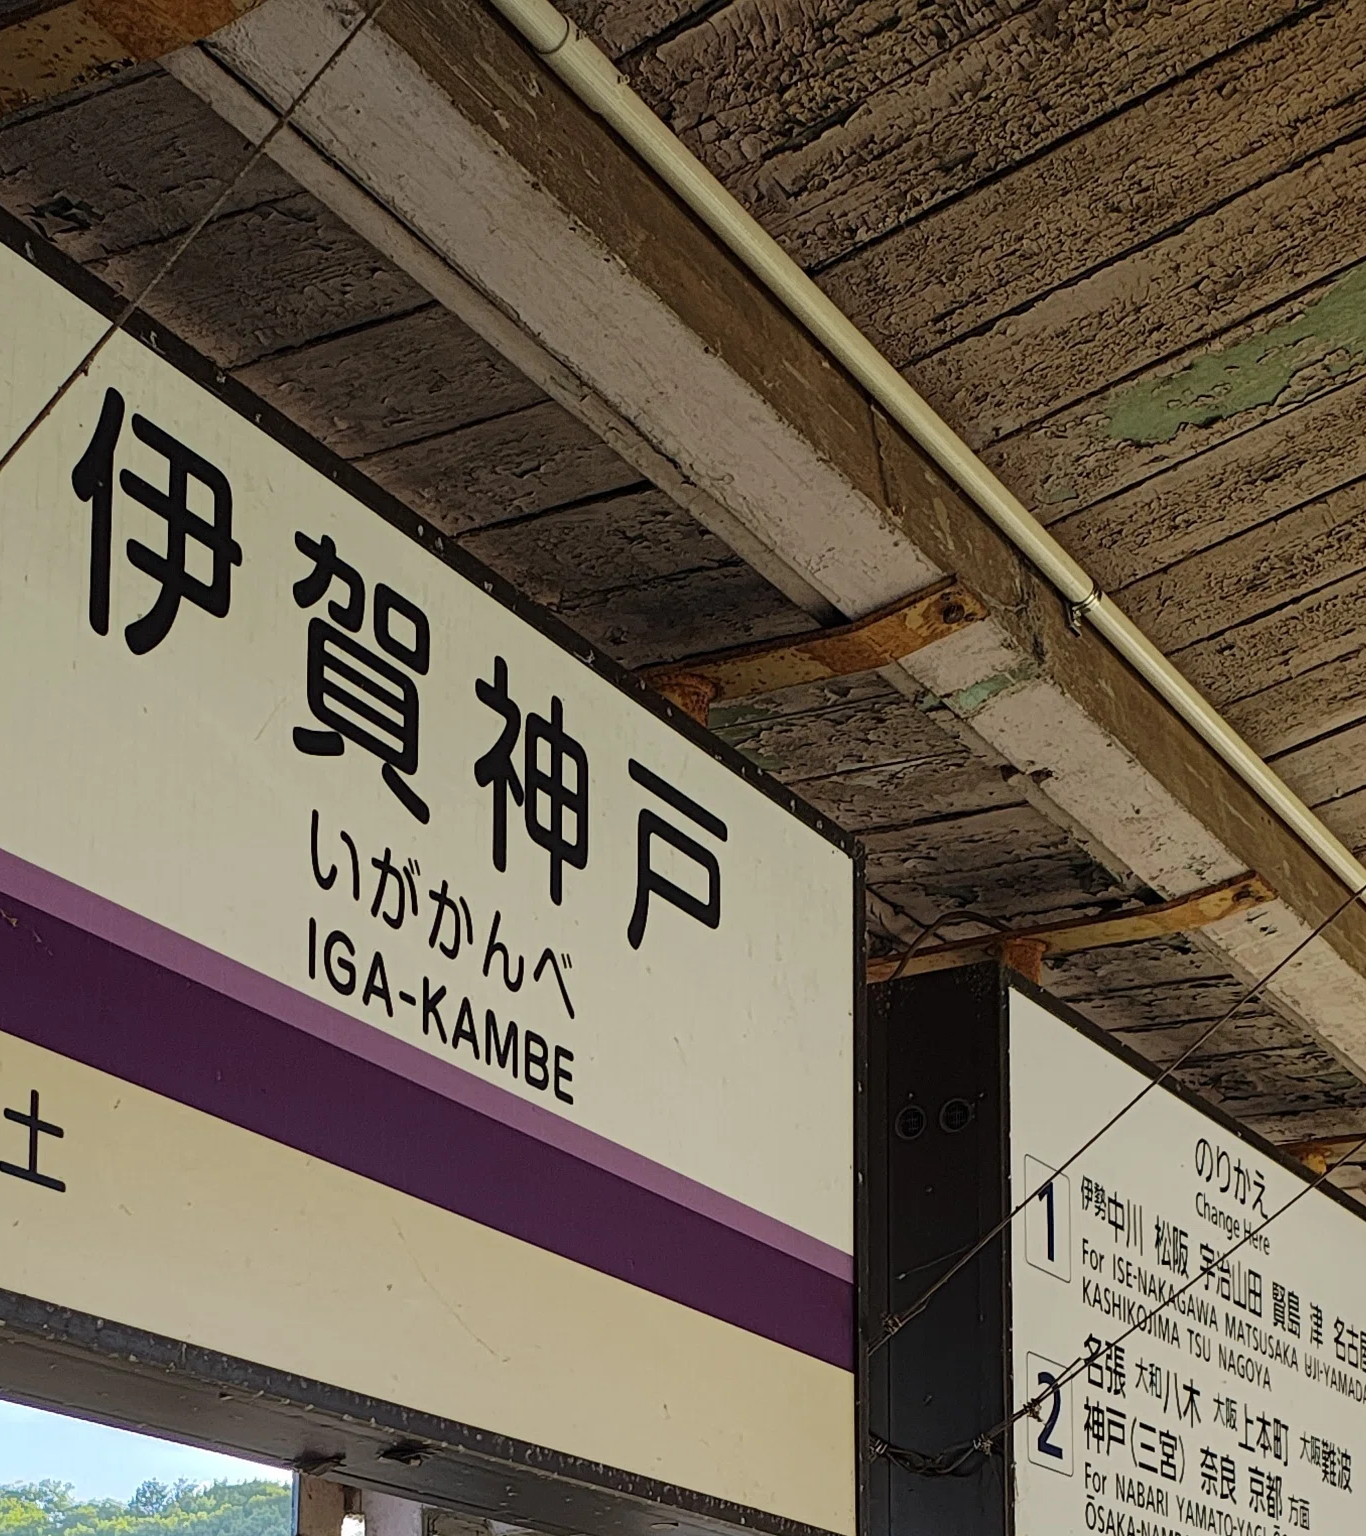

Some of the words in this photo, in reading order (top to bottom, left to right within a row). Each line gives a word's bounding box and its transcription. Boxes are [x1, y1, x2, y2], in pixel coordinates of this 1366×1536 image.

[69, 386, 729, 950] 伊賀神戸
[308, 808, 578, 1018] いがかんべ
[308, 920, 576, 1105] IGA-KAMBE
[1037, 1180, 1056, 1263] 1
[1193, 1137, 1270, 1221] のりかえ
[1195, 1191, 1241, 1241] Change
[1243, 1218, 1271, 1256] Here
[1080, 1174, 1145, 1257] 伊勢中川
[1154, 1214, 1190, 1280] 松阪
[1199, 1242, 1263, 1319] 宇治山田
[1271, 1280, 1302, 1340] 賢島
[1308, 1301, 1324, 1350] 津
[1081, 1237, 1106, 1274] For
[1112, 1253, 1219, 1333] ISE-NAKAGAWA
[1224, 1310, 1300, 1373] MATSUSAKA
[1081, 1275, 1181, 1350] KASHIKOJIMA
[1186, 1327, 1212, 1364] TSU
[1218, 1342, 1273, 1393] NAGOYA
[1036, 1370, 1064, 1461] 2
[1082, 1332, 1127, 1400] 名張
[1134, 1356, 1202, 1430] 大和八木
[1212, 1392, 1290, 1468] 大阪上本町
[1299, 1430, 1354, 1495] 大阪難波
[1084, 1461, 1108, 1496] For
[1115, 1472, 1170, 1518] NABARI
[1199, 1445, 1238, 1506] 奈良
[1247, 1465, 1284, 1522] 京都
[1287, 1493, 1311, 1532] 方面
